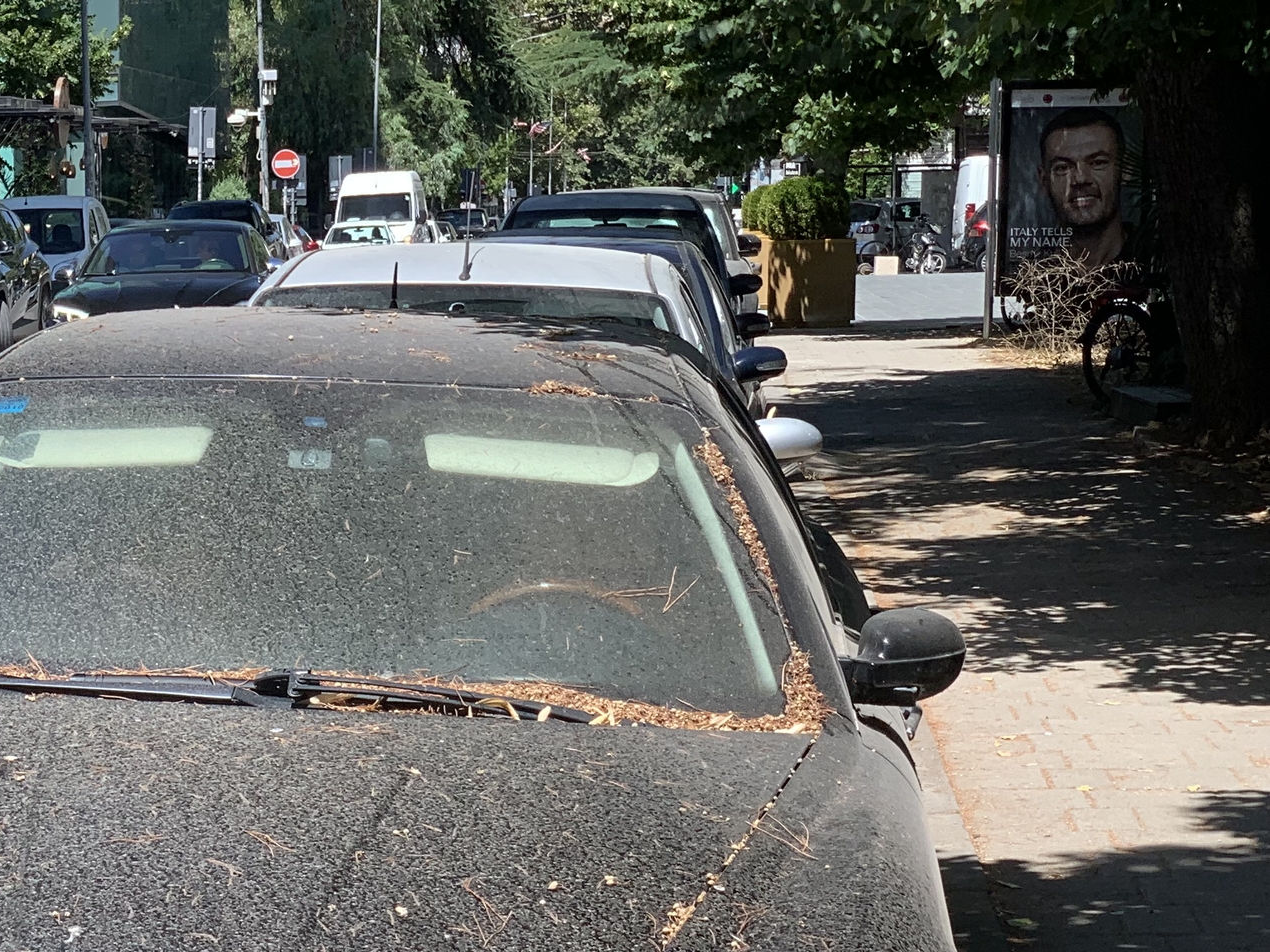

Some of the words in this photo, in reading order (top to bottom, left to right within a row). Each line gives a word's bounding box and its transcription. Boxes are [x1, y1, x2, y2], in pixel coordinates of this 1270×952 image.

[1010, 227, 1039, 236] ITALY
[1041, 227, 1074, 236] TELLS
[1010, 237, 1030, 247] MY
[1032, 236, 1073, 247] NAME.
